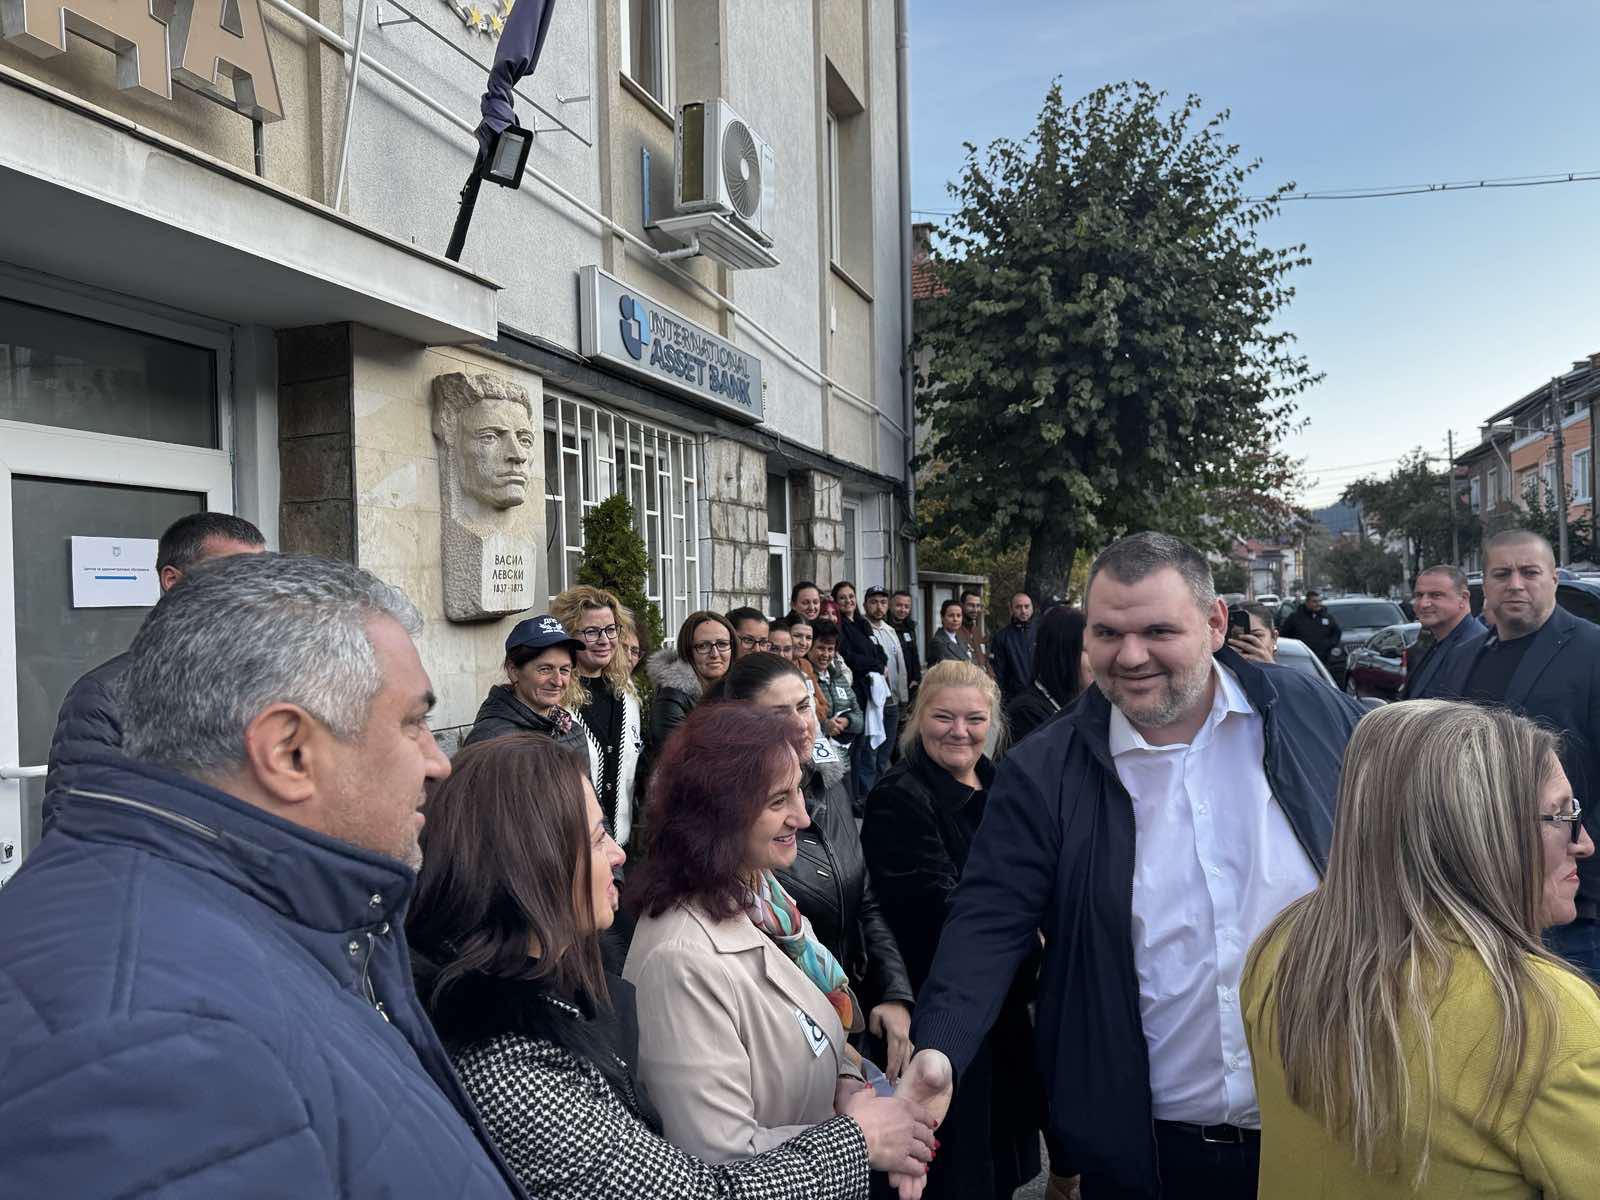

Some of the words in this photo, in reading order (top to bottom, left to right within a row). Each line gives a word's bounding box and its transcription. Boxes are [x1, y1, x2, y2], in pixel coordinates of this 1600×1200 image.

[649, 310, 751, 378] INTERNATIONAL
[649, 338, 707, 386] ASSET
[709, 364, 752, 407] BANK
[492, 569, 524, 580] ЛЕВСКИ
[494, 554, 523, 566] ВАСИЛ
